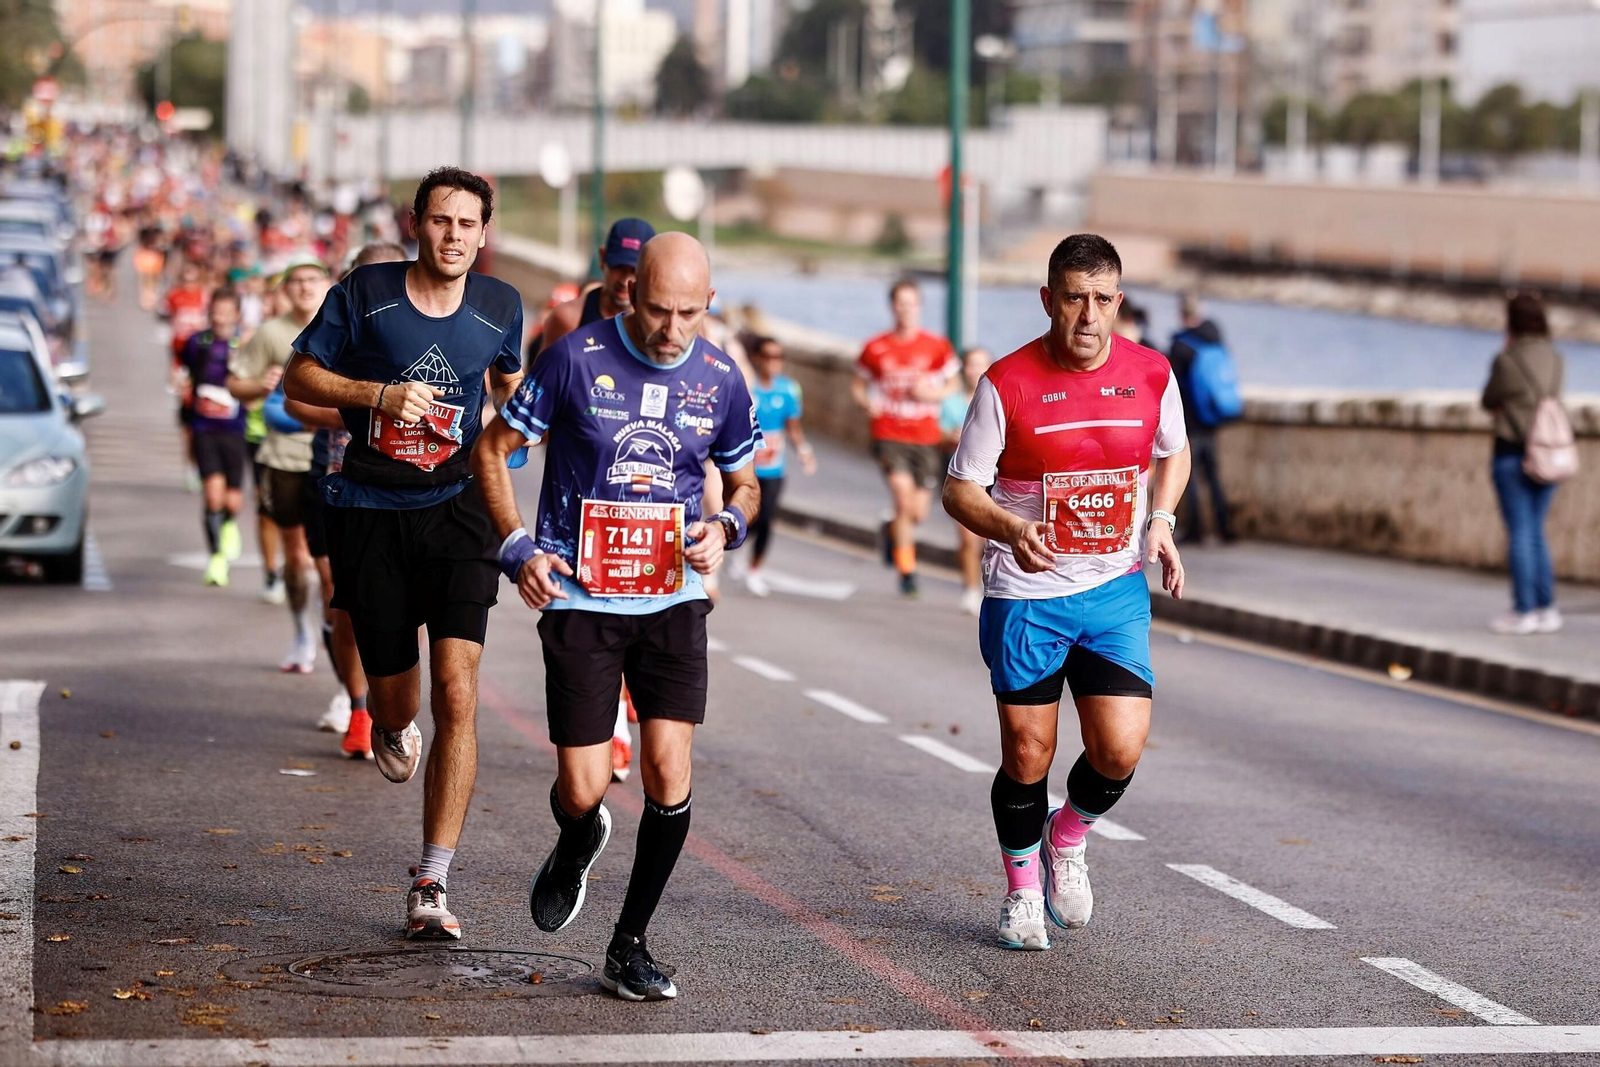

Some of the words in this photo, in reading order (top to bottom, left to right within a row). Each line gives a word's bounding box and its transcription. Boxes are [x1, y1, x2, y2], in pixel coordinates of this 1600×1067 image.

[1042, 391, 1067, 403] GOBIK
[612, 420, 645, 443] NUEVA
[646, 420, 682, 452] MÁLAGA
[615, 463, 635, 473] TRAIL
[1071, 472, 1127, 487] GENERALI
[1068, 492, 1115, 510] 6466
[609, 506, 671, 520] GENERALI
[605, 526, 653, 546] 7141
[622, 547, 651, 556] SOMOZA
